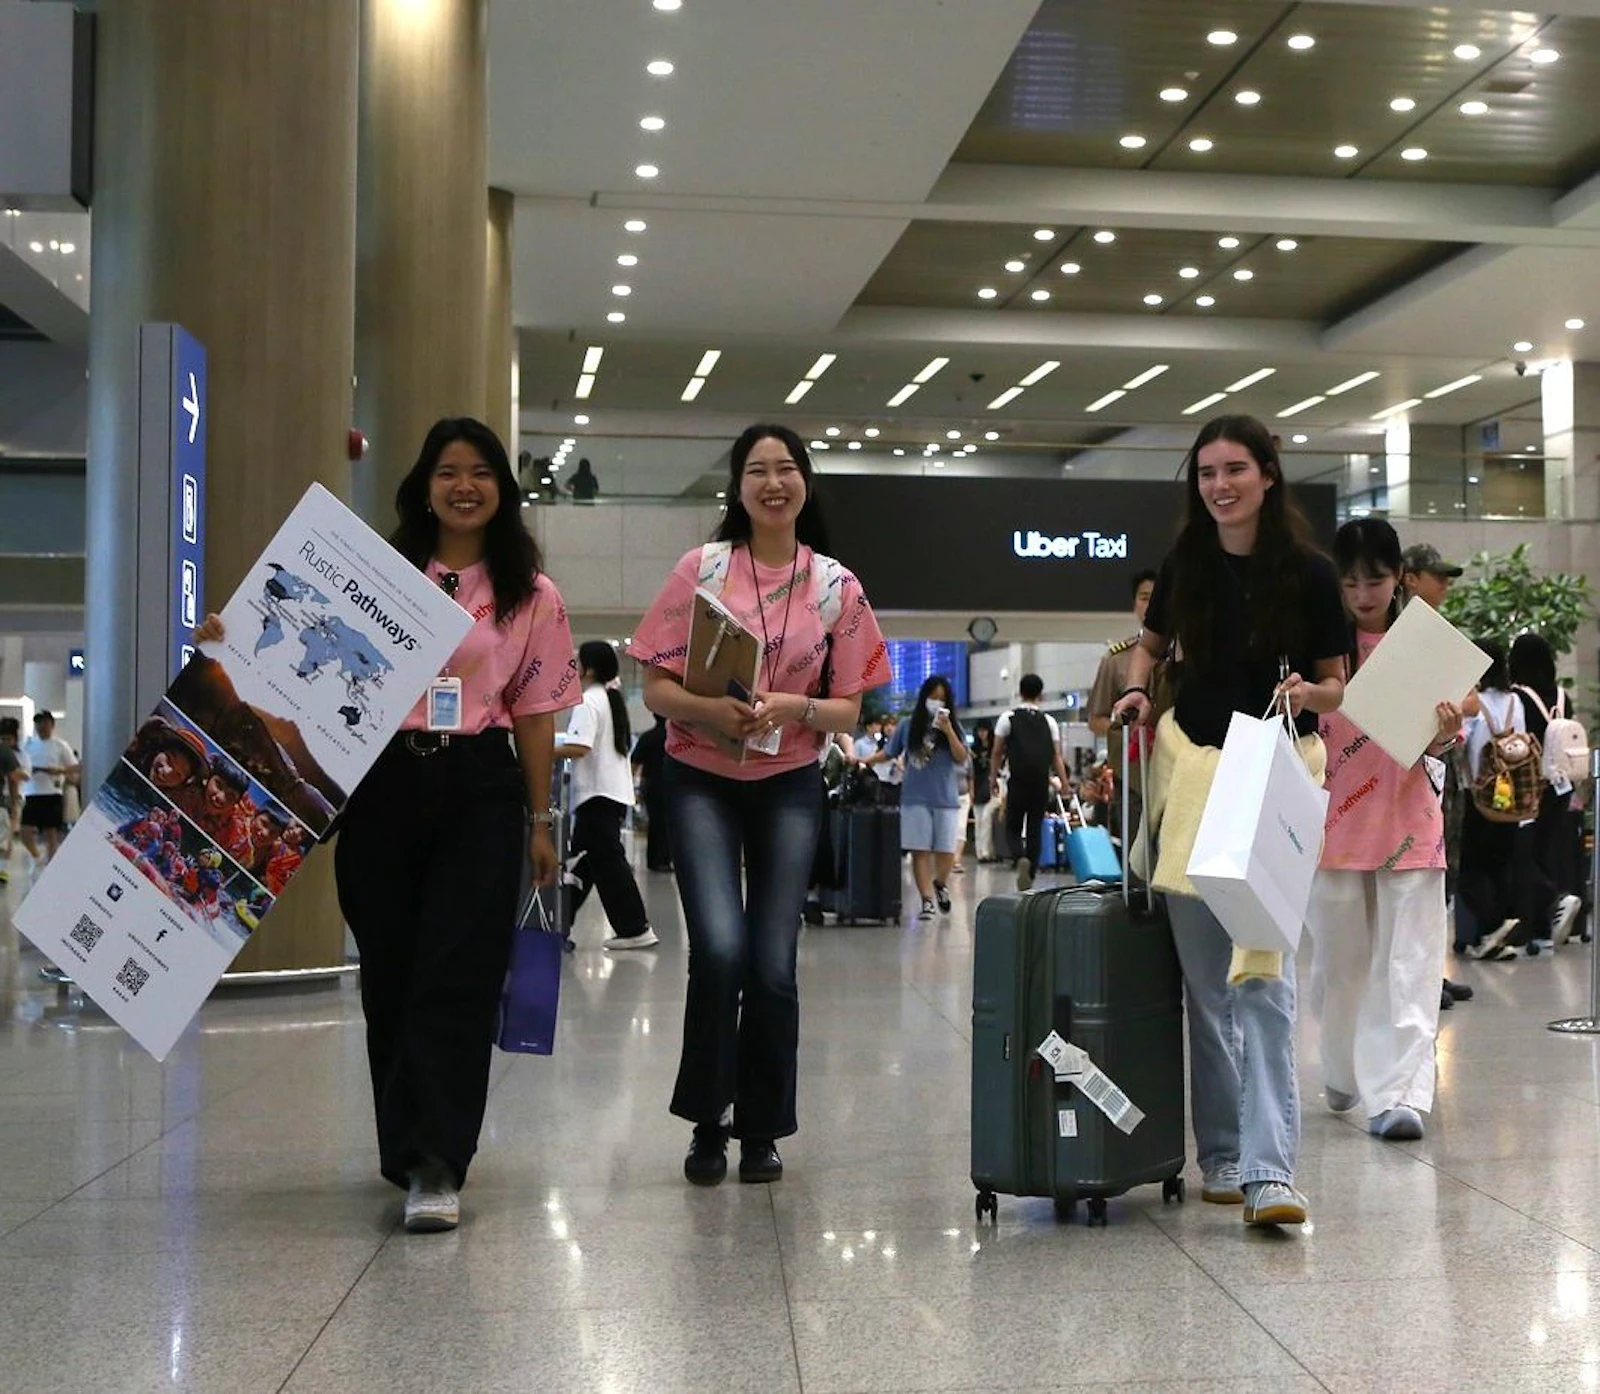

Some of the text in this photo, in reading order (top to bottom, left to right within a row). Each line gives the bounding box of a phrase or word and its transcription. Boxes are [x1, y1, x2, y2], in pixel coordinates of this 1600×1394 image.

[1013, 530, 1128, 558] Uber Taxi
[298, 539, 346, 588] Rustic
[341, 578, 418, 653] Pathways
[1337, 775, 1380, 818] Pathways
